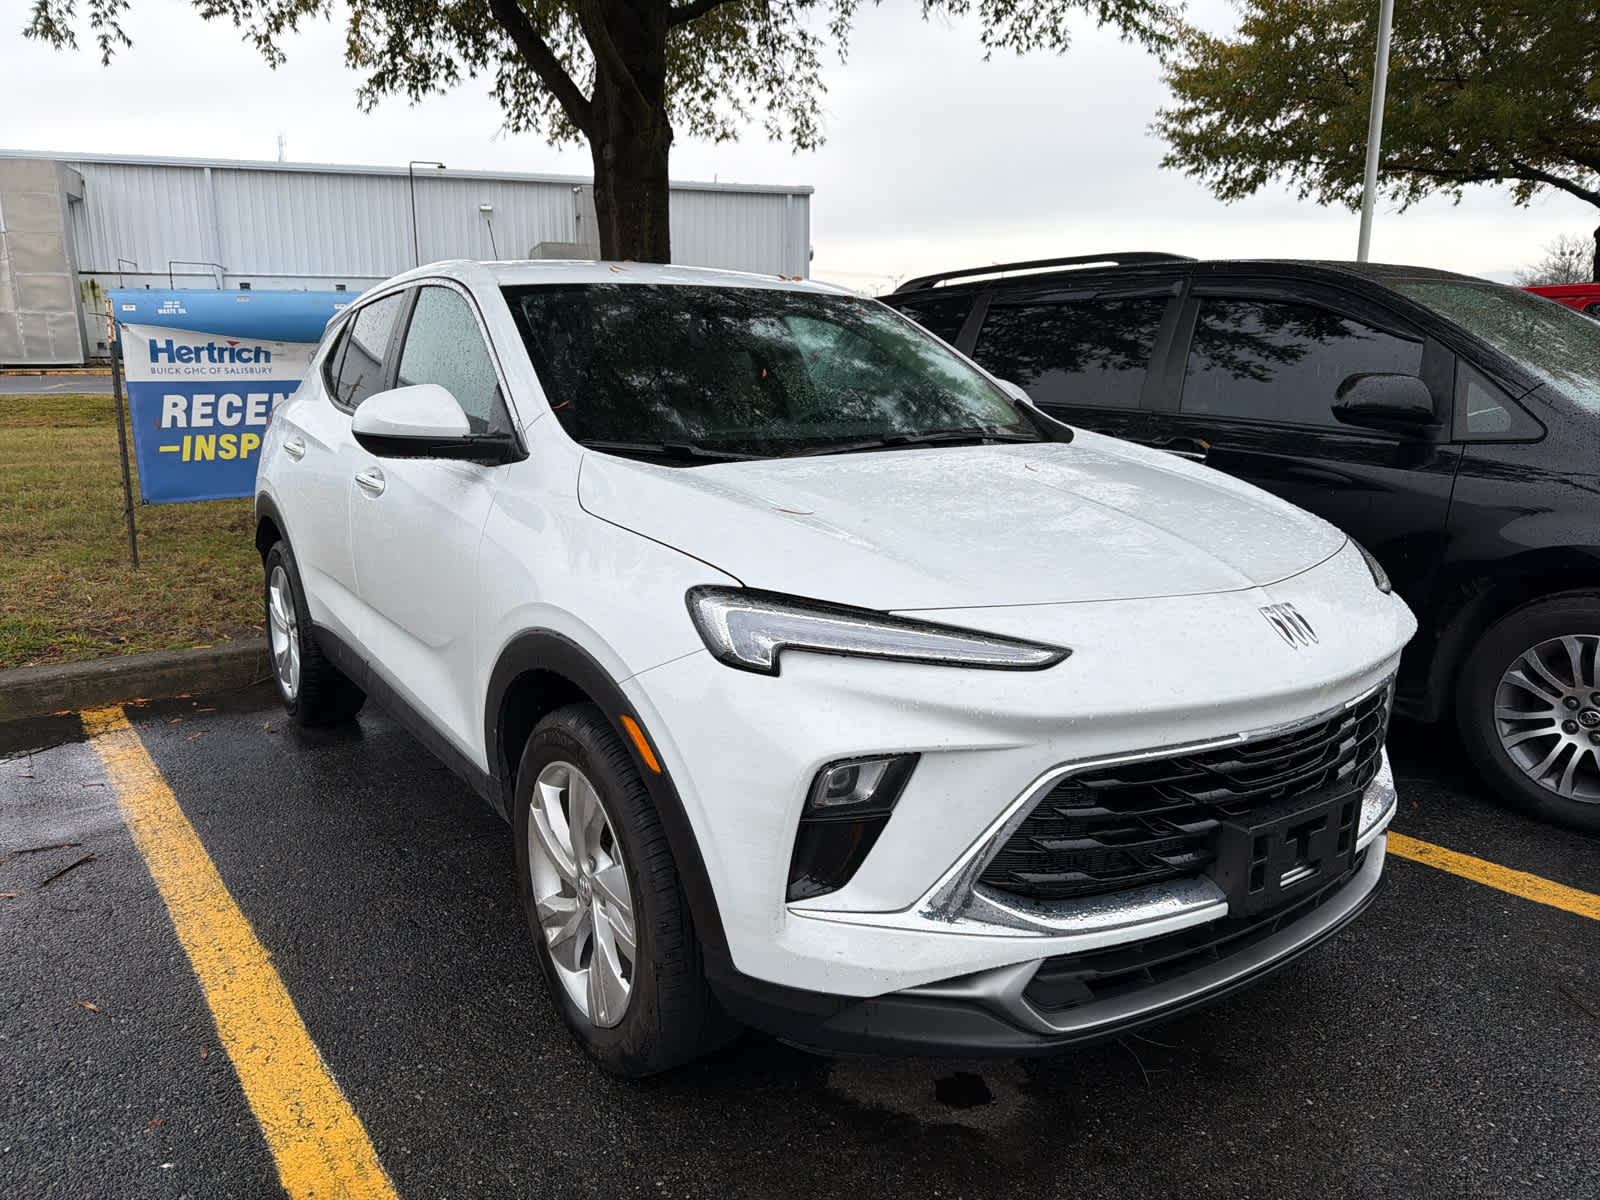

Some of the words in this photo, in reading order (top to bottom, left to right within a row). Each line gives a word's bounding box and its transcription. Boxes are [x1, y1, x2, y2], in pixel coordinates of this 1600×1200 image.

[149, 339, 271, 364] Hertrich
[151, 367, 181, 375] BUICK
[184, 367, 207, 375] GMC
[209, 367, 221, 375] OF
[224, 367, 272, 375] SALISBURY
